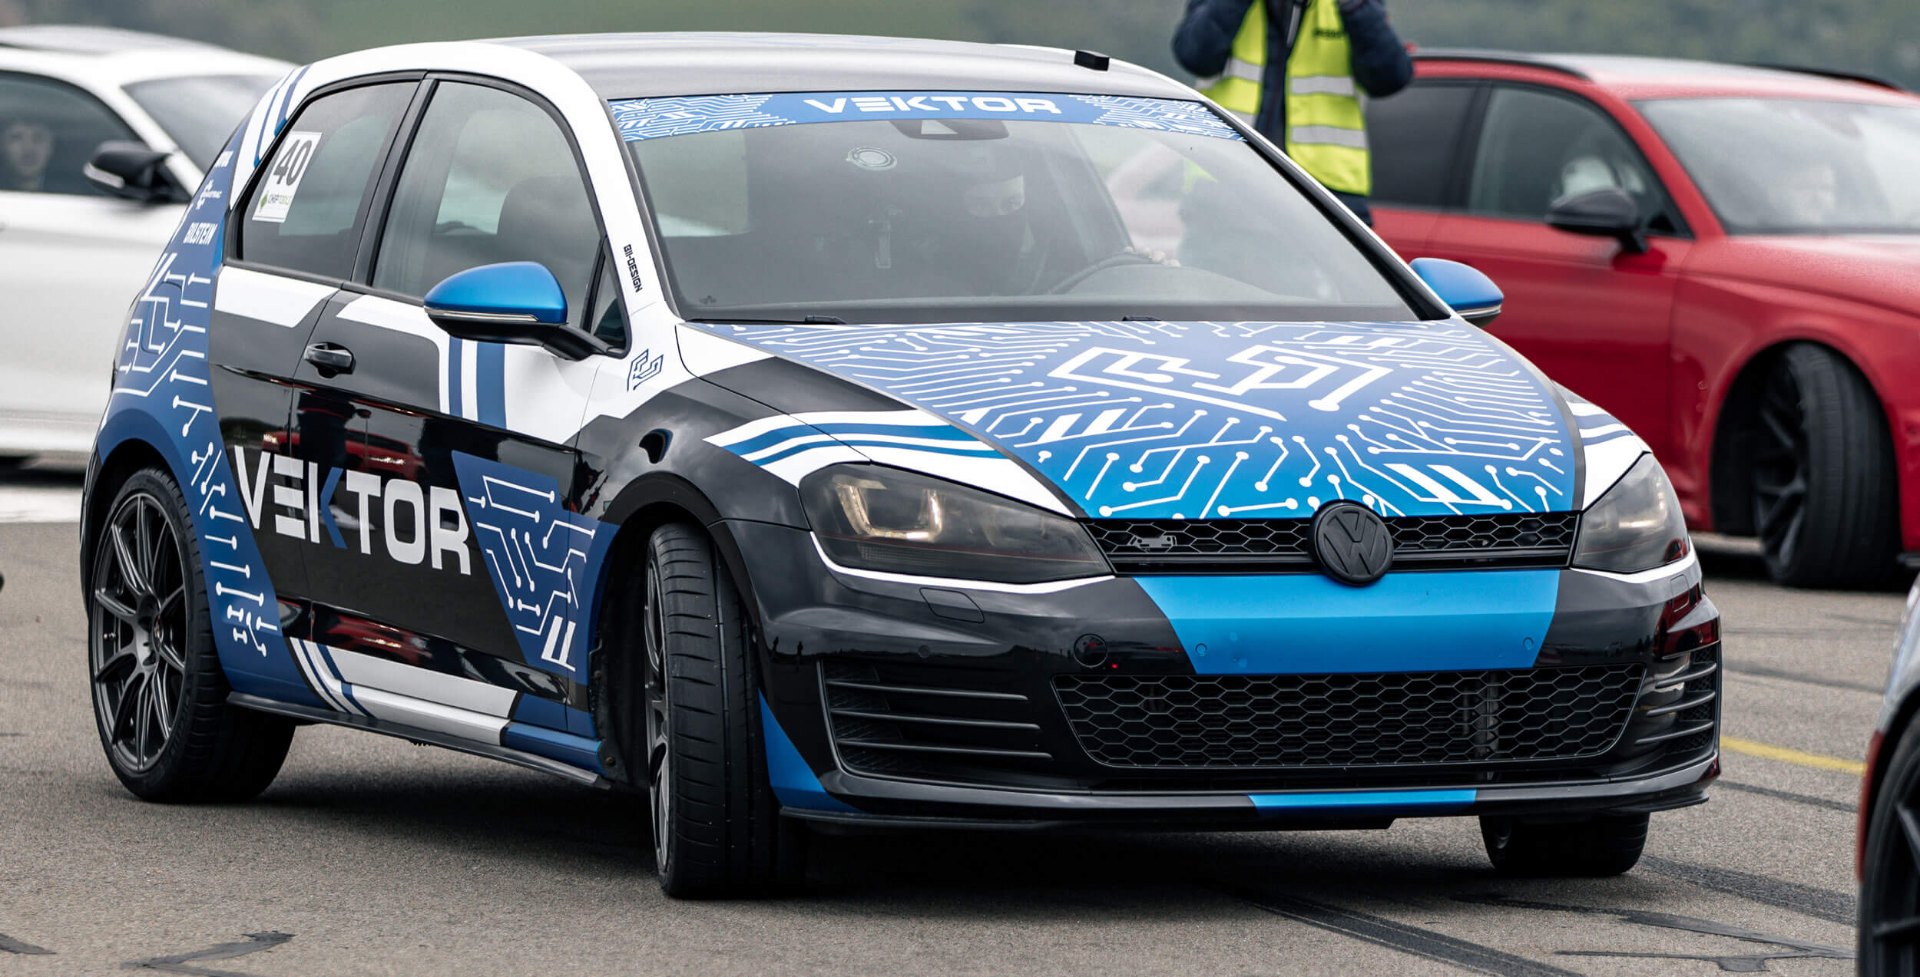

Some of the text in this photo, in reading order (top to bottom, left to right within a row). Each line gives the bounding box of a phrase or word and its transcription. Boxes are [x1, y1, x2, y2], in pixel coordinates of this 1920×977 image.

[803, 96, 1062, 114] VEKTOR
[273, 139, 312, 187] 40
[234, 445, 471, 575] VEKTOR
